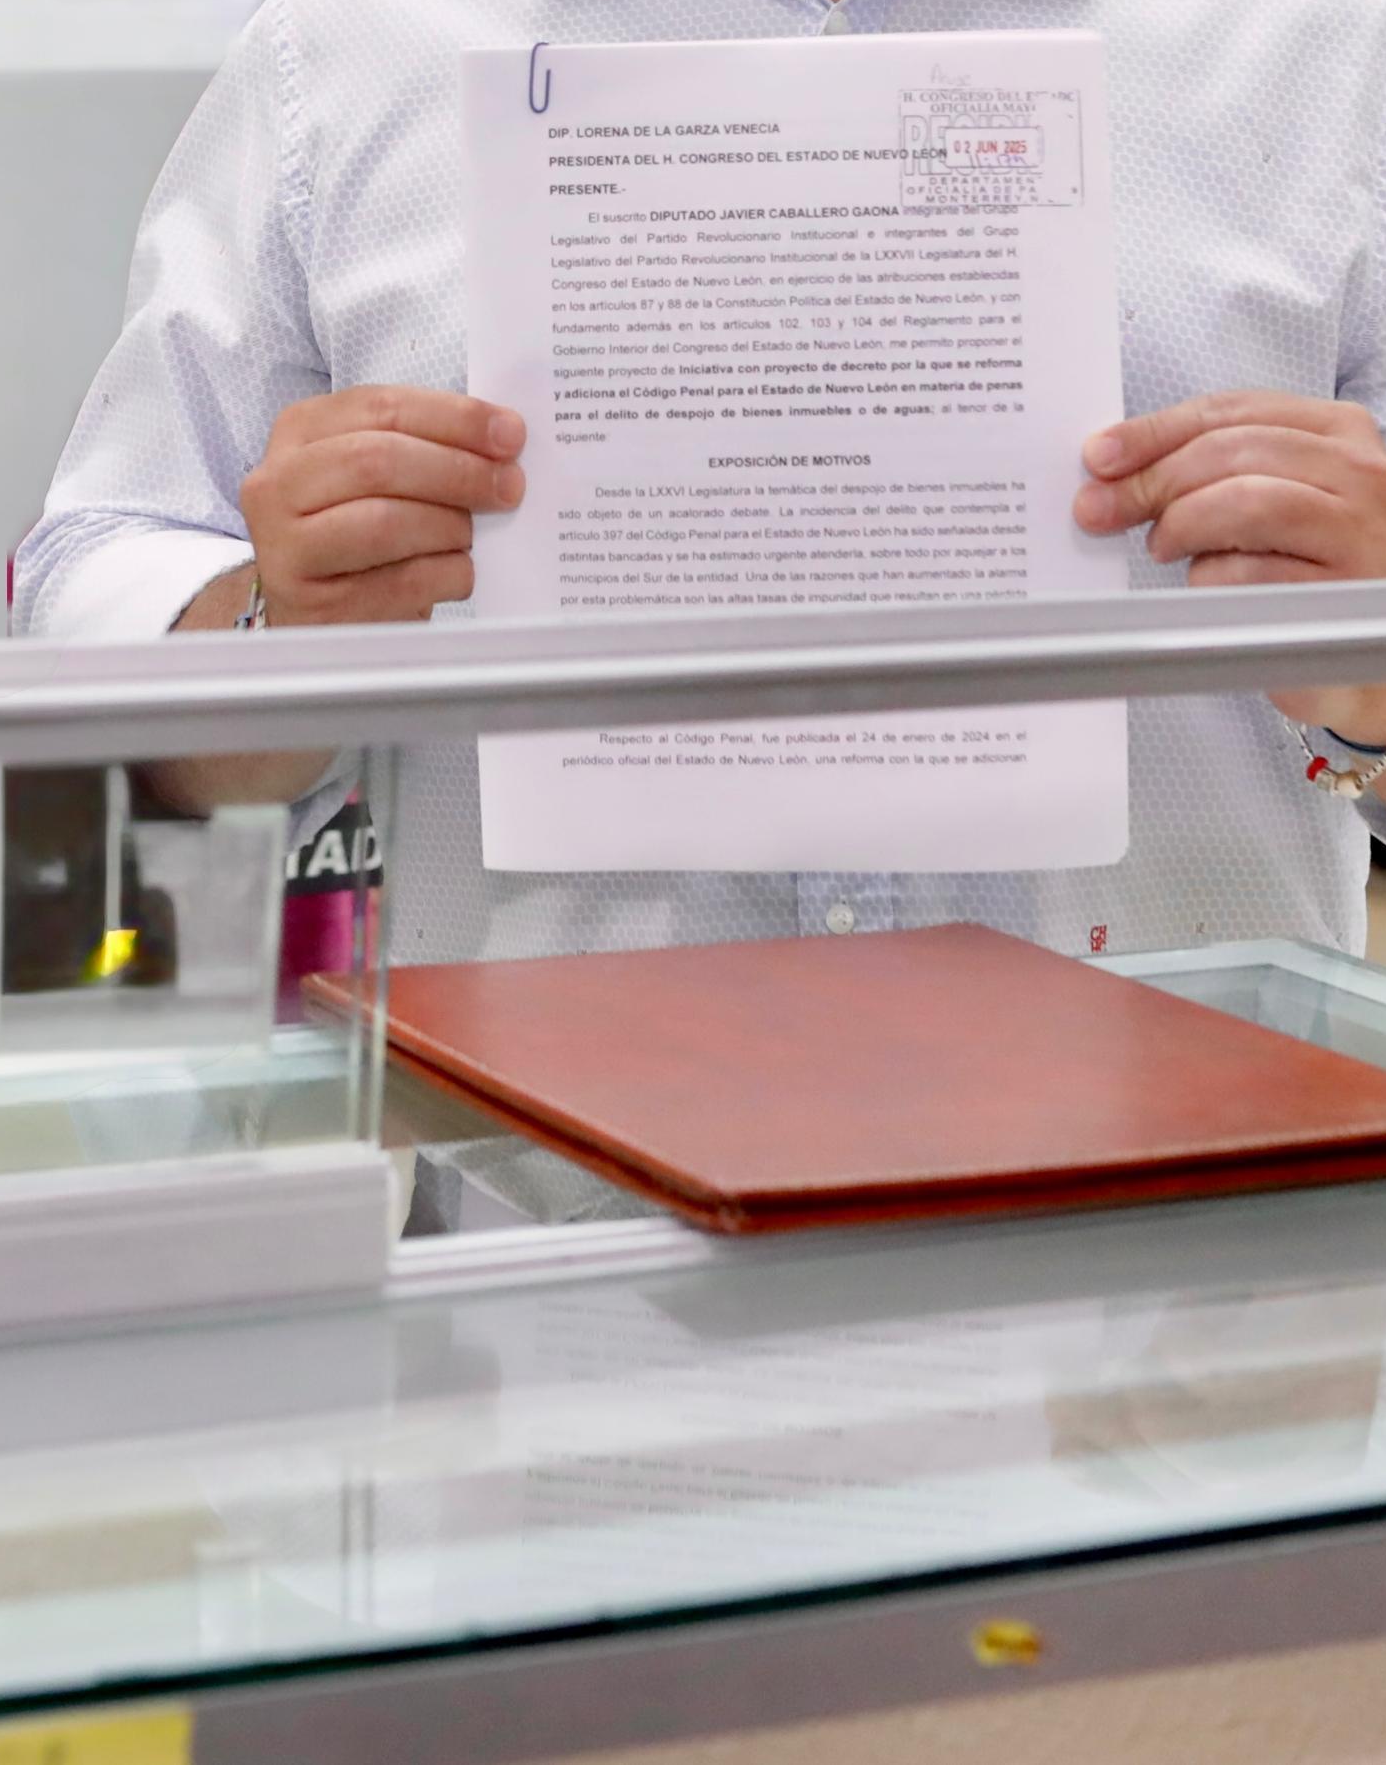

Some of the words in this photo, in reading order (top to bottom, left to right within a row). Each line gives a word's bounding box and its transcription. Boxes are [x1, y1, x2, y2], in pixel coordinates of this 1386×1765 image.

[919, 92, 993, 103] CONGRESO
[998, 91, 1023, 102] DEL
[930, 104, 999, 113] OFICIALIA
[576, 127, 630, 138] LORENA
[633, 126, 651, 137] DE
[655, 126, 671, 136] LA
[675, 125, 720, 136] GARZA
[723, 123, 780, 134] VENECIA
[976, 140, 998, 153] JUN
[549, 155, 630, 167] PRESIDENTA
[634, 155, 659, 165] DEL
[679, 152, 754, 164] CONGRESO
[757, 152, 782, 162] DEL
[786, 150, 839, 162] ESTADO
[842, 150, 860, 160] DE
[863, 147, 909, 160] NUEVO
[995, 185, 1011, 194] DE
[603, 212, 647, 223] suscrito
[650, 210, 716, 222] DIPUTADO
[720, 209, 765, 220] JAVIER
[769, 207, 849, 219] CABALLERO
[852, 206, 899, 217] GAONA
[551, 235, 611, 248] Legislativo
[647, 233, 687, 243] Partido
[697, 232, 781, 242] Revolucionario
[791, 229, 858, 240] Institucional
[551, 257, 611, 270] Legislativo
[637, 255, 677, 266] Partido
[681, 254, 766, 265] Revolucionario
[770, 252, 838, 262] Institucional
[874, 249, 915, 261] LXXVII
[551, 279, 607, 292] Congreso
[631, 277, 671, 288] Estado
[693, 276, 730, 286] Nuevo
[787, 275, 835, 286] ejercicio
[877, 272, 946, 283] atribuciones
[640, 299, 655, 310] 87
[667, 299, 682, 309] 88
[715, 297, 786, 309] Constitución
[854, 294, 895, 305] Estado
[552, 323, 620, 333] fundamento
[811, 317, 831, 328] 103
[853, 316, 872, 327] 104
[552, 345, 605, 356] Gobierno
[609, 344, 648, 354] Interior
[673, 342, 728, 355] Congreso
[752, 341, 793, 352] Estado
[813, 340, 851, 350] Nuevo
[553, 367, 604, 379] siguiente
[608, 366, 657, 379] proyecto
[679, 365, 733, 374] Iniciativa
[738, 365, 760, 373] con
[764, 363, 818, 375] proyecto
[841, 361, 887, 371] decreto
[891, 362, 912, 372] por
[930, 361, 953, 371] que
[957, 361, 971, 369] se
[975, 358, 1023, 368] reforma
[564, 389, 616, 399] adiciona
[633, 387, 677, 400] Código
[680, 386, 714, 396] Penal
[717, 388, 744, 398] para
[761, 385, 804, 395] Estado
[825, 384, 864, 393] Nuevo
[867, 383, 898, 393] León
[901, 384, 916, 392] en
[919, 382, 965, 391] materia
[986, 382, 1023, 392] penas
[555, 413, 581, 422] para
[605, 410, 639, 419] delito
[666, 409, 715, 420] despojo
[742, 408, 783, 417] bienes
[789, 406, 852, 416] inmuebles
[708, 455, 788, 468] EXPOSICIÓN
[791, 456, 808, 466] DE
[812, 455, 871, 466] MOTIVOS
[595, 487, 632, 498] Desde
[649, 486, 685, 497] LXXVI
[689, 486, 751, 499] Legislatura
[841, 484, 886, 495] despojo
[558, 509, 581, 519] sido
[587, 509, 622, 521] objeto
[669, 508, 725, 519] acalorado
[800, 507, 857, 516] incidencia
[603, 530, 623, 541] 397
[645, 530, 686, 542] Código
[688, 529, 721, 539] Penal
[723, 531, 749, 540] para
[764, 528, 804, 539] Estado
[823, 527, 861, 537] Nuevo
[863, 527, 892, 537] León
[559, 553, 605, 562] distintas
[608, 552, 663, 562] bancadas
[709, 551, 761, 561] estimado
[764, 550, 807, 563] urgente
[560, 574, 619, 585] municipios
[809, 572, 855, 581] razones
[582, 595, 606, 605] esta
[727, 594, 754, 603] altas
[757, 594, 788, 603] tasas
[808, 592, 867, 603] impunidad
[600, 733, 653, 745] Respecto
[674, 733, 715, 746] Código
[786, 733, 840, 745] publicada
[862, 732, 876, 742] 24
[562, 755, 614, 768] periódico
[618, 755, 650, 765] oficial
[676, 754, 715, 765] Estado
[738, 755, 775, 765] Nuevo
[841, 754, 885, 764] reforma
